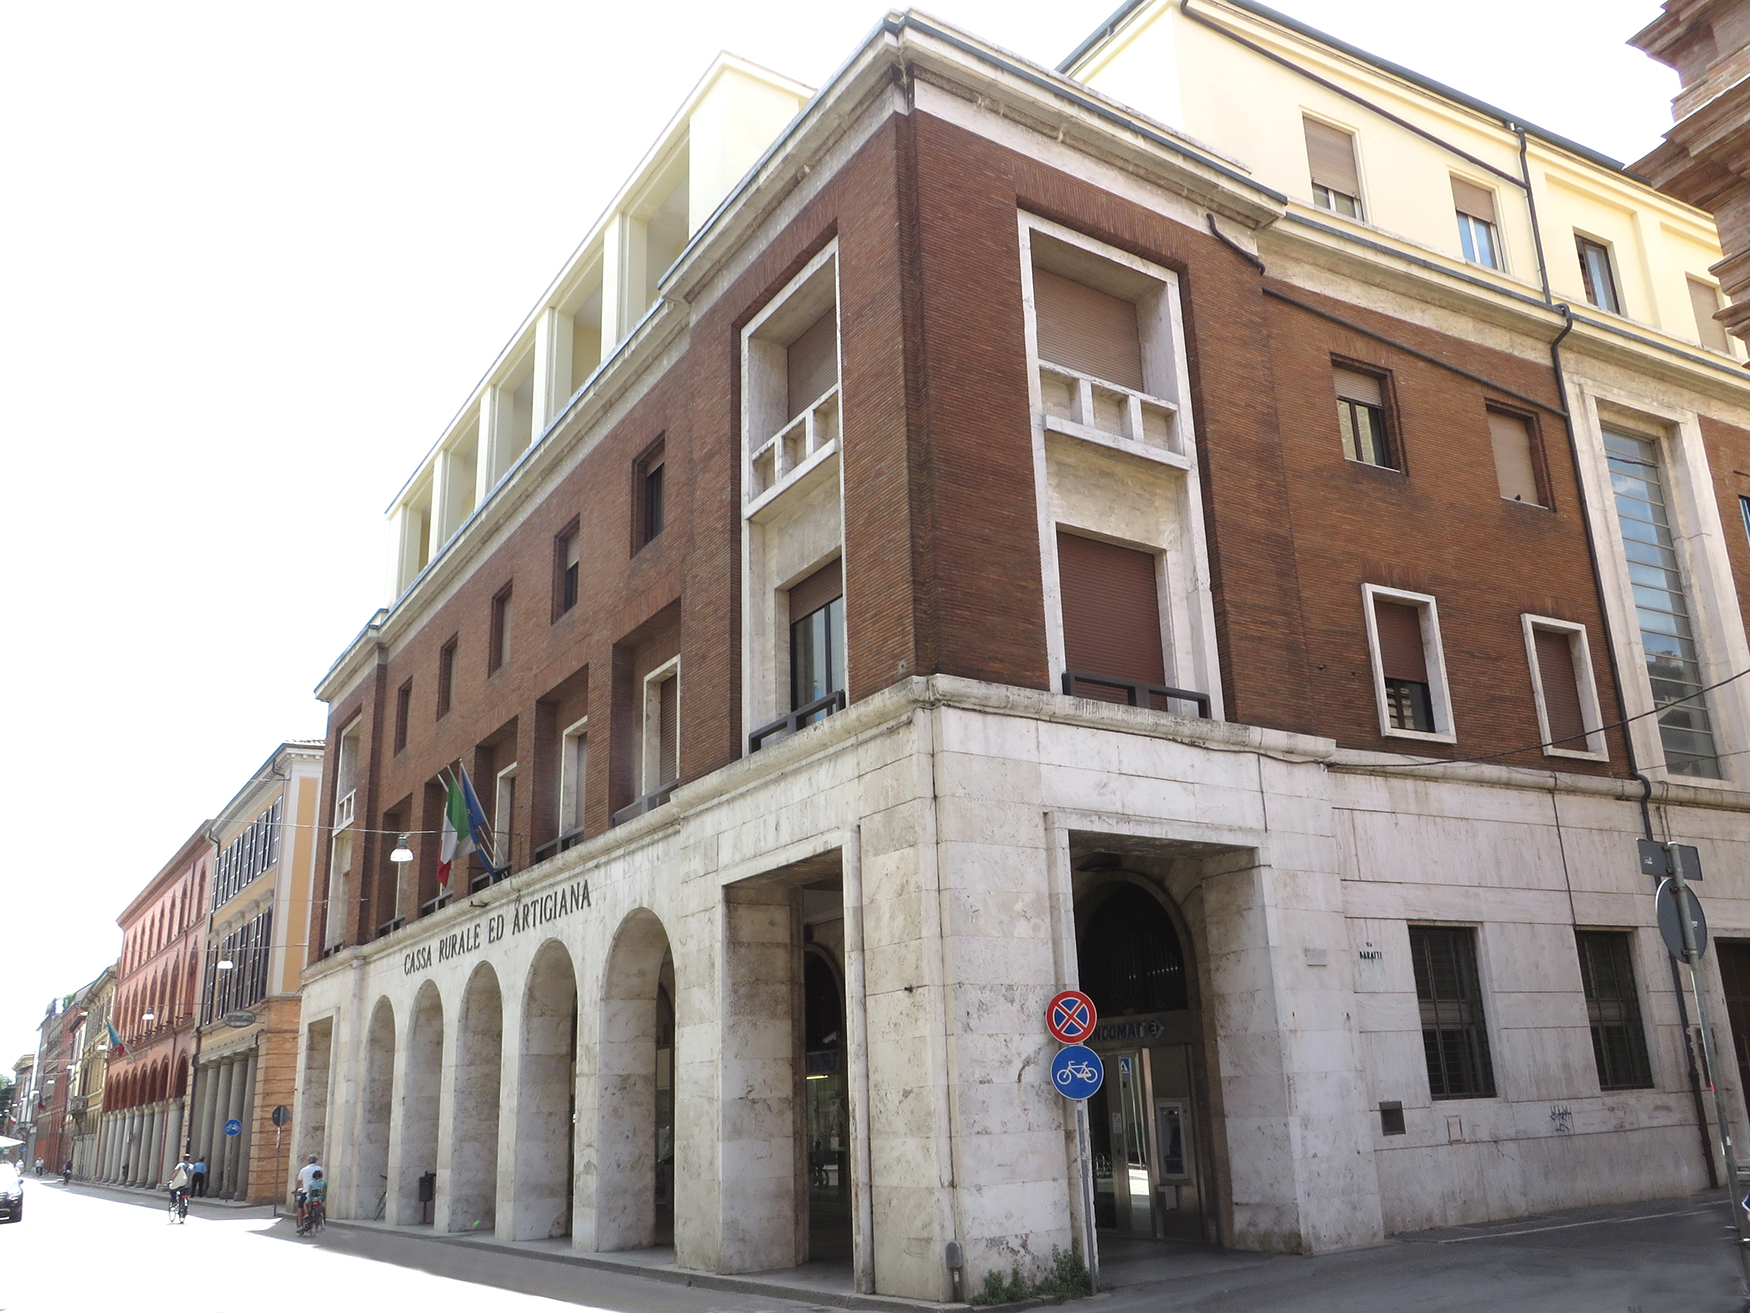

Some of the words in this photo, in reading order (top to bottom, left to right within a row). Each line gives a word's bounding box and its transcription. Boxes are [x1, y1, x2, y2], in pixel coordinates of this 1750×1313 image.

[404, 946, 432, 975] CASSA
[439, 923, 481, 963] RURALE
[488, 914, 505, 944] ED
[512, 879, 592, 936] ARTIGIANA
[1087, 1022, 1146, 1041] NCOMAT
